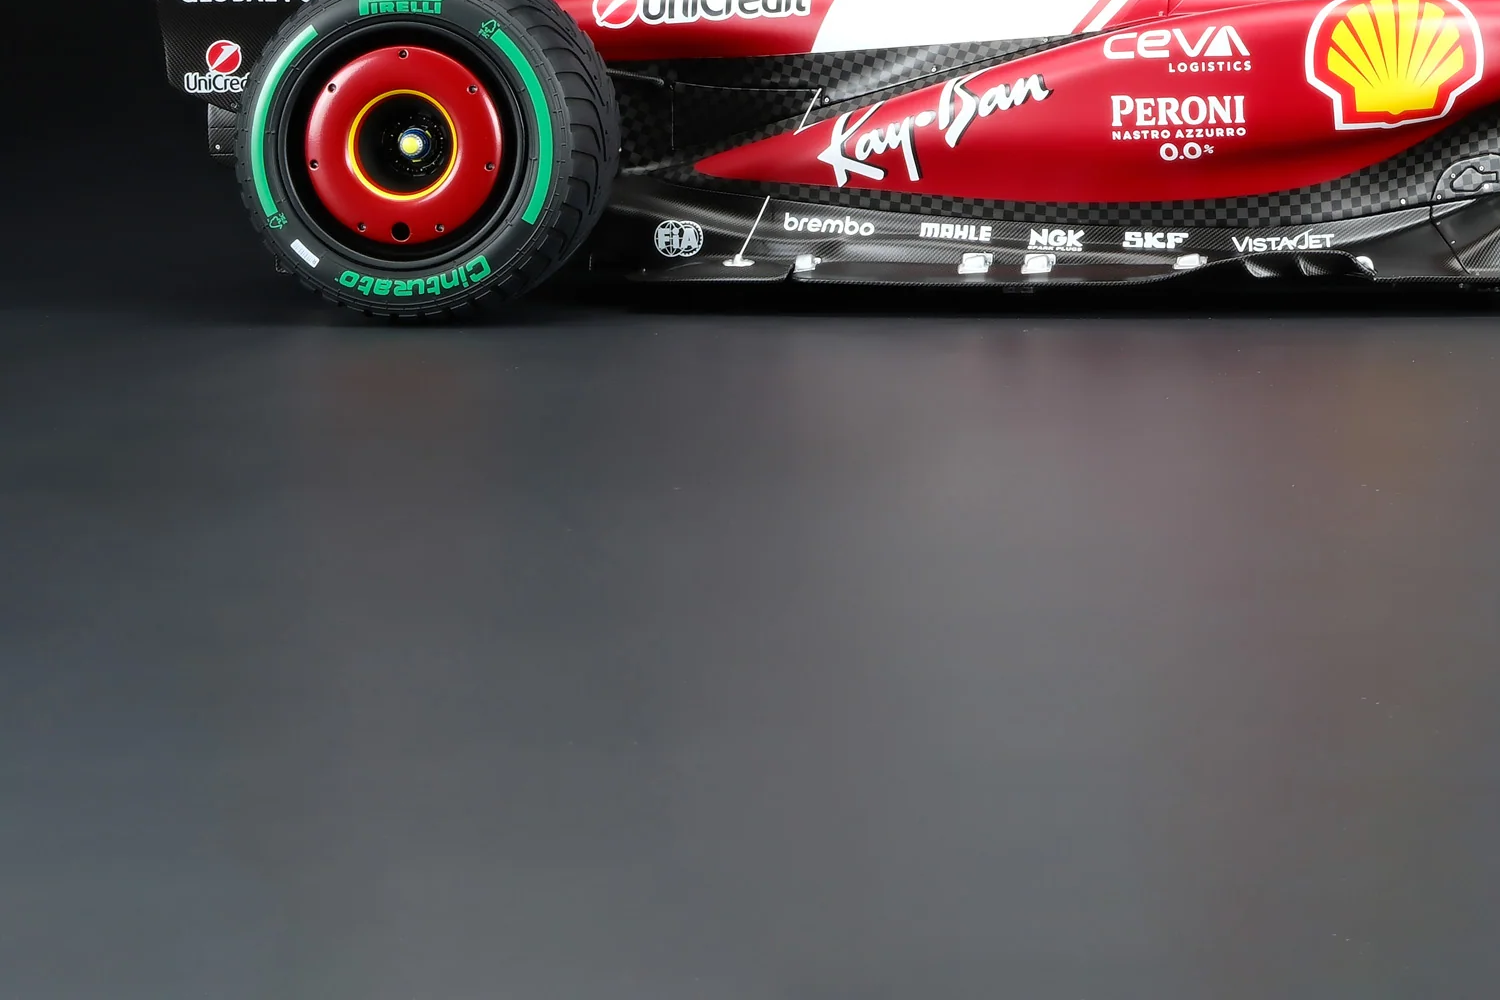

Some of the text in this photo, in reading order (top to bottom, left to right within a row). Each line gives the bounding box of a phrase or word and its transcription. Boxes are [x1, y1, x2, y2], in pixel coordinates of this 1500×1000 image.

[1168, 60, 1252, 73] LOGISTICS
[185, 72, 249, 93] UniCre
[1110, 95, 1246, 127] PERONI
[1112, 127, 1247, 140] NASTRO AZZURRO
[1159, 141, 1214, 161] 0.0%
[784, 213, 875, 236] brembo
[920, 222, 992, 242] MAHLE
[1029, 228, 1085, 247] NGK
[1122, 231, 1189, 249] SKF
